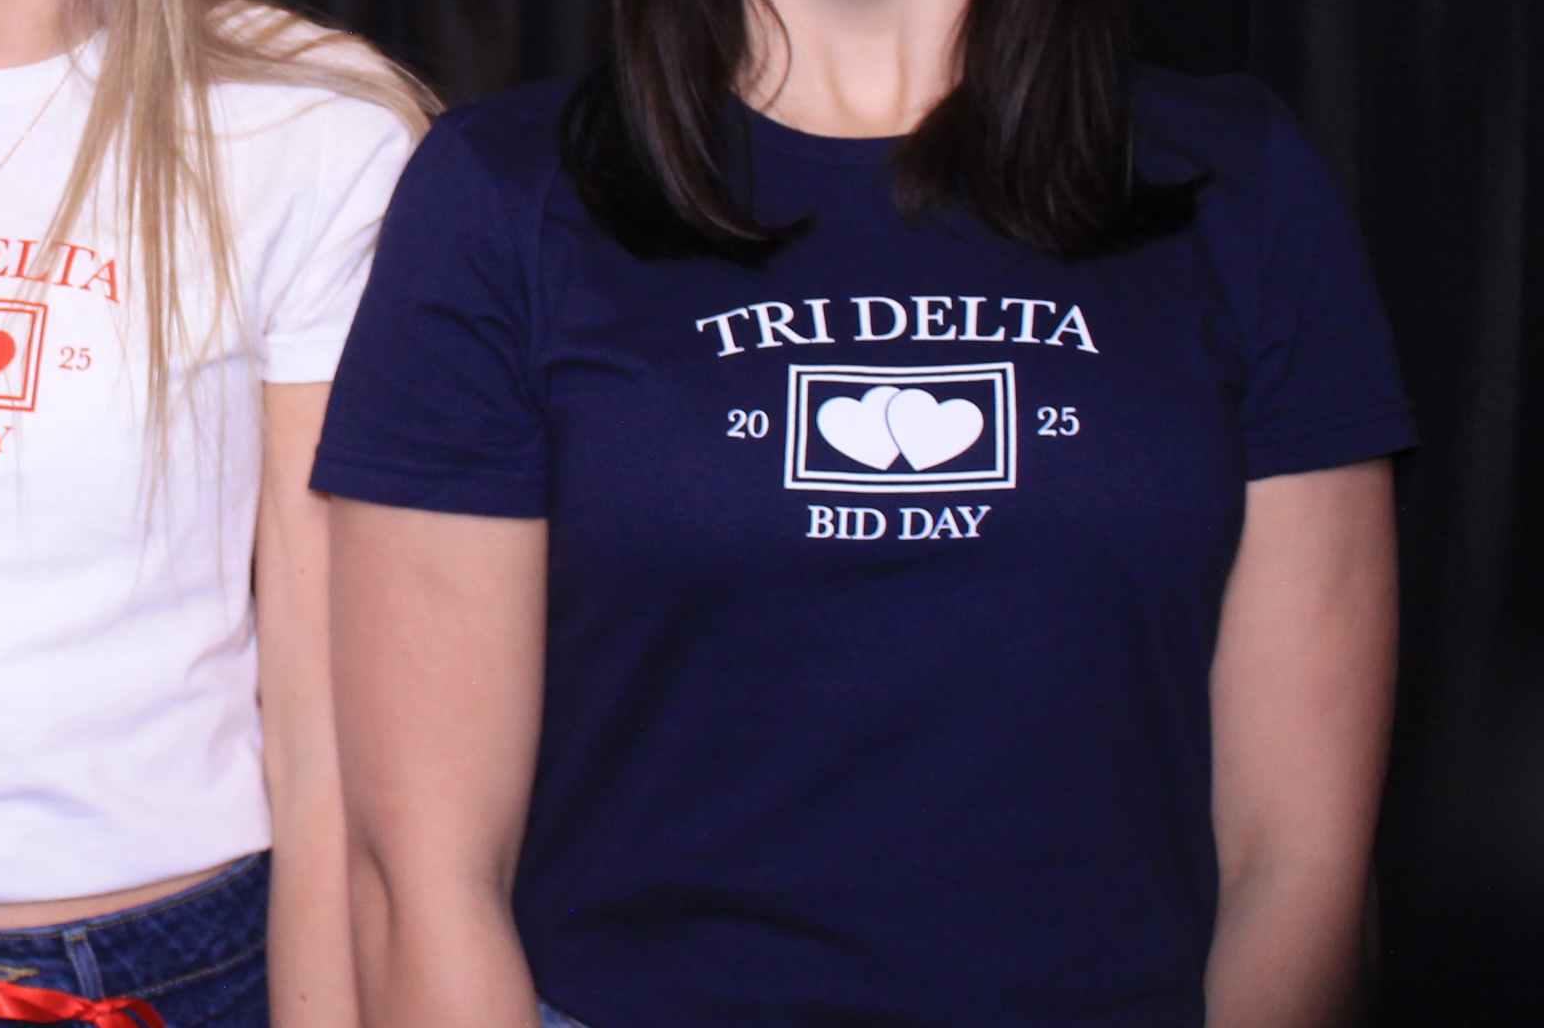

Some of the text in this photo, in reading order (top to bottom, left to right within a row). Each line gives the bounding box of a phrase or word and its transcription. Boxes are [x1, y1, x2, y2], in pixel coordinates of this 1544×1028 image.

[695, 294, 1099, 357] TRI DELTA
[58, 346, 92, 371] 25
[726, 406, 1080, 439] 20 25
[805, 504, 992, 540] BID DAY
